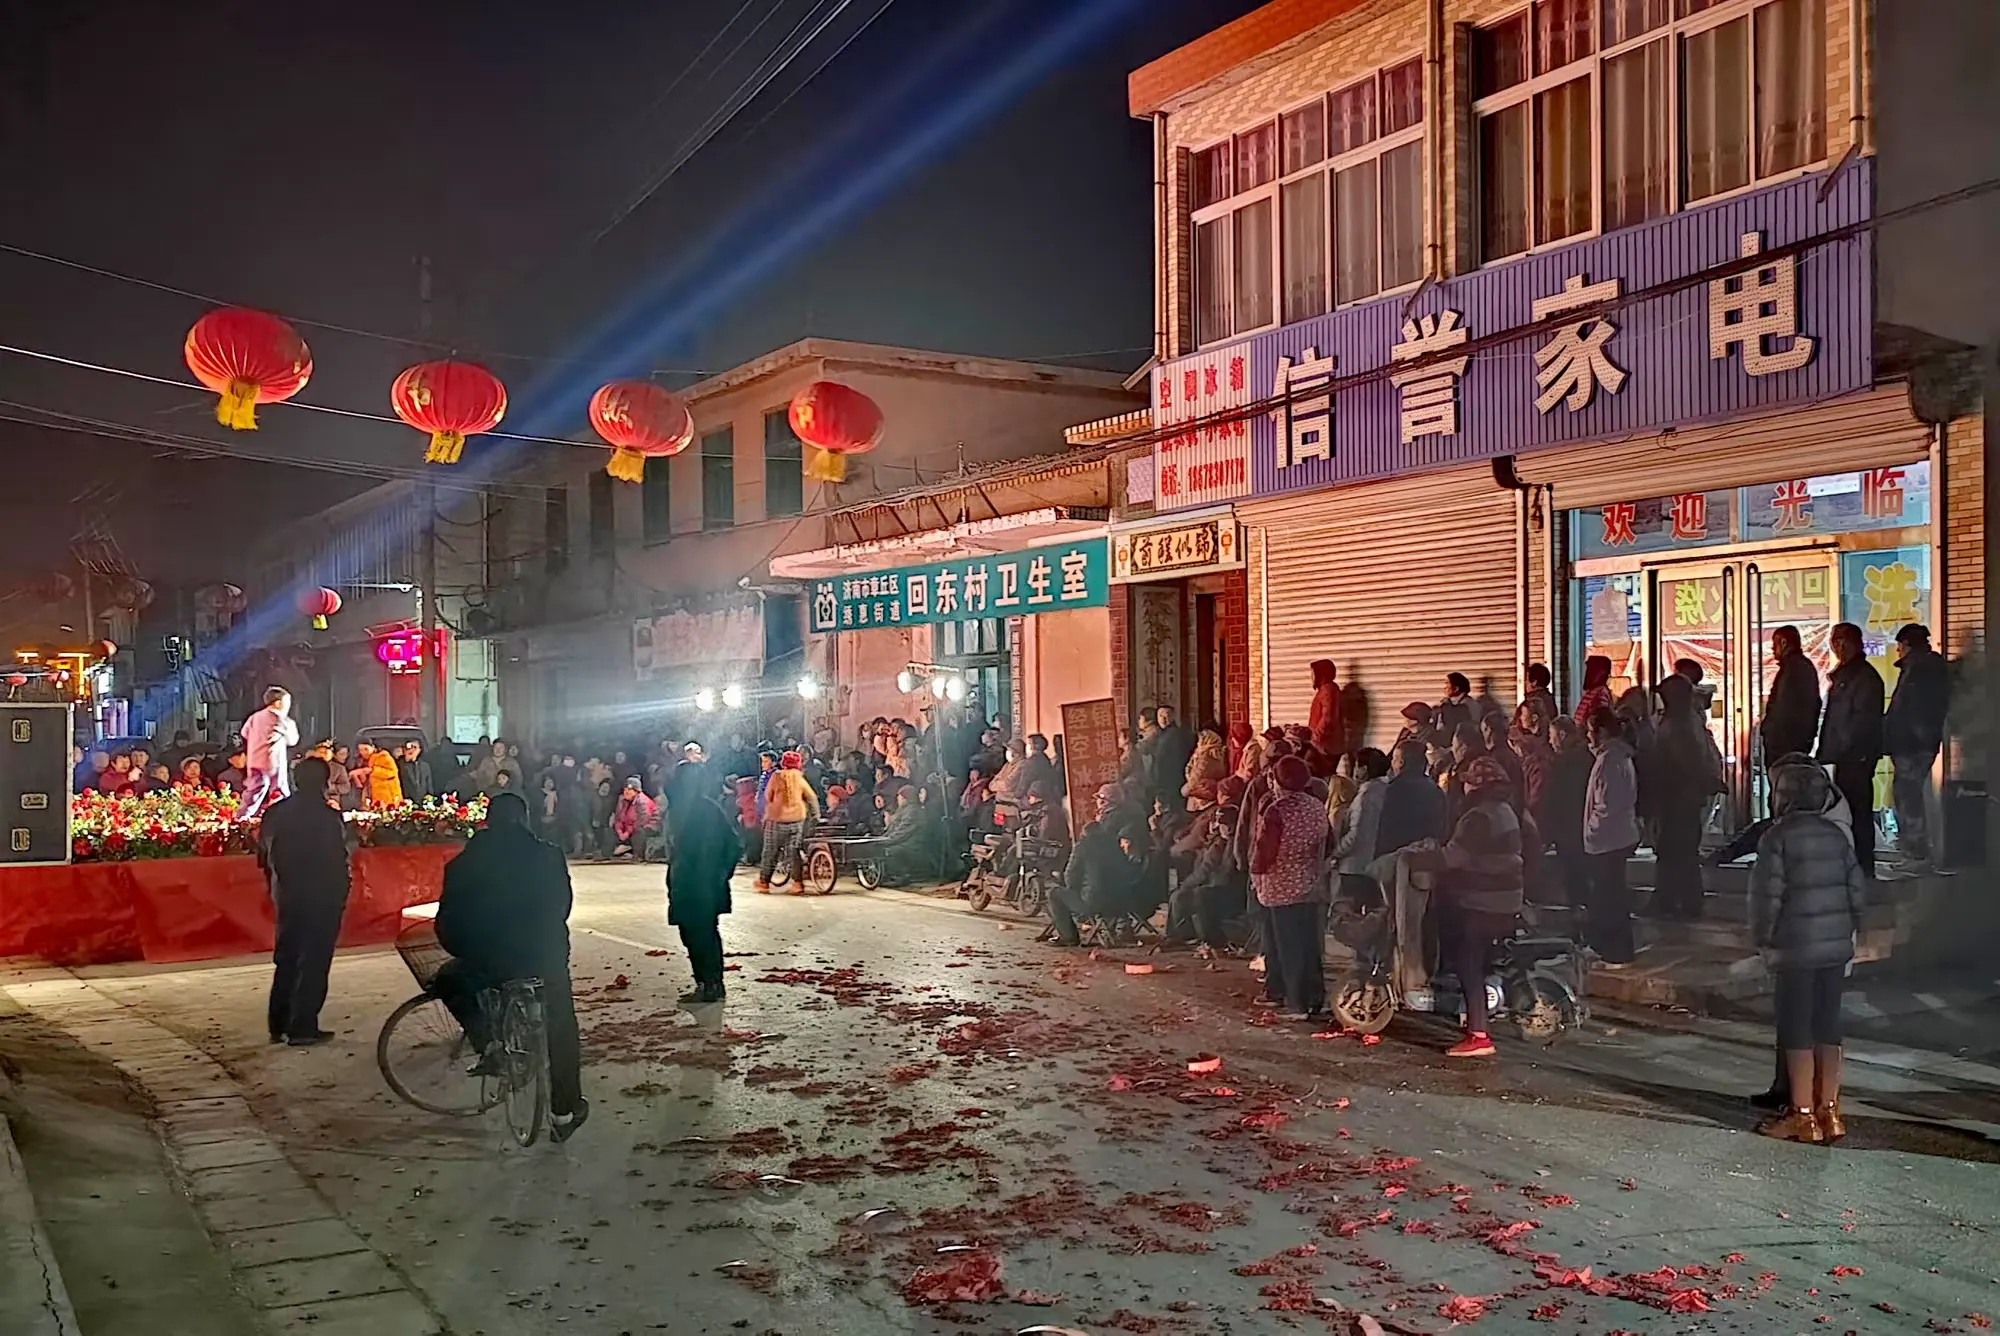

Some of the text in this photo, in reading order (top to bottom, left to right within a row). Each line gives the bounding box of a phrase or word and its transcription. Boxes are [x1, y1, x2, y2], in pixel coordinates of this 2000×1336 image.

[1269, 231, 1816, 469] 信誉家电
[1602, 466, 1906, 547] 欢迎光临
[1139, 523, 1210, 567] 前程似锦
[842, 574, 900, 600] 济南市章丘区
[907, 550, 1089, 616] 回东村卫生室
